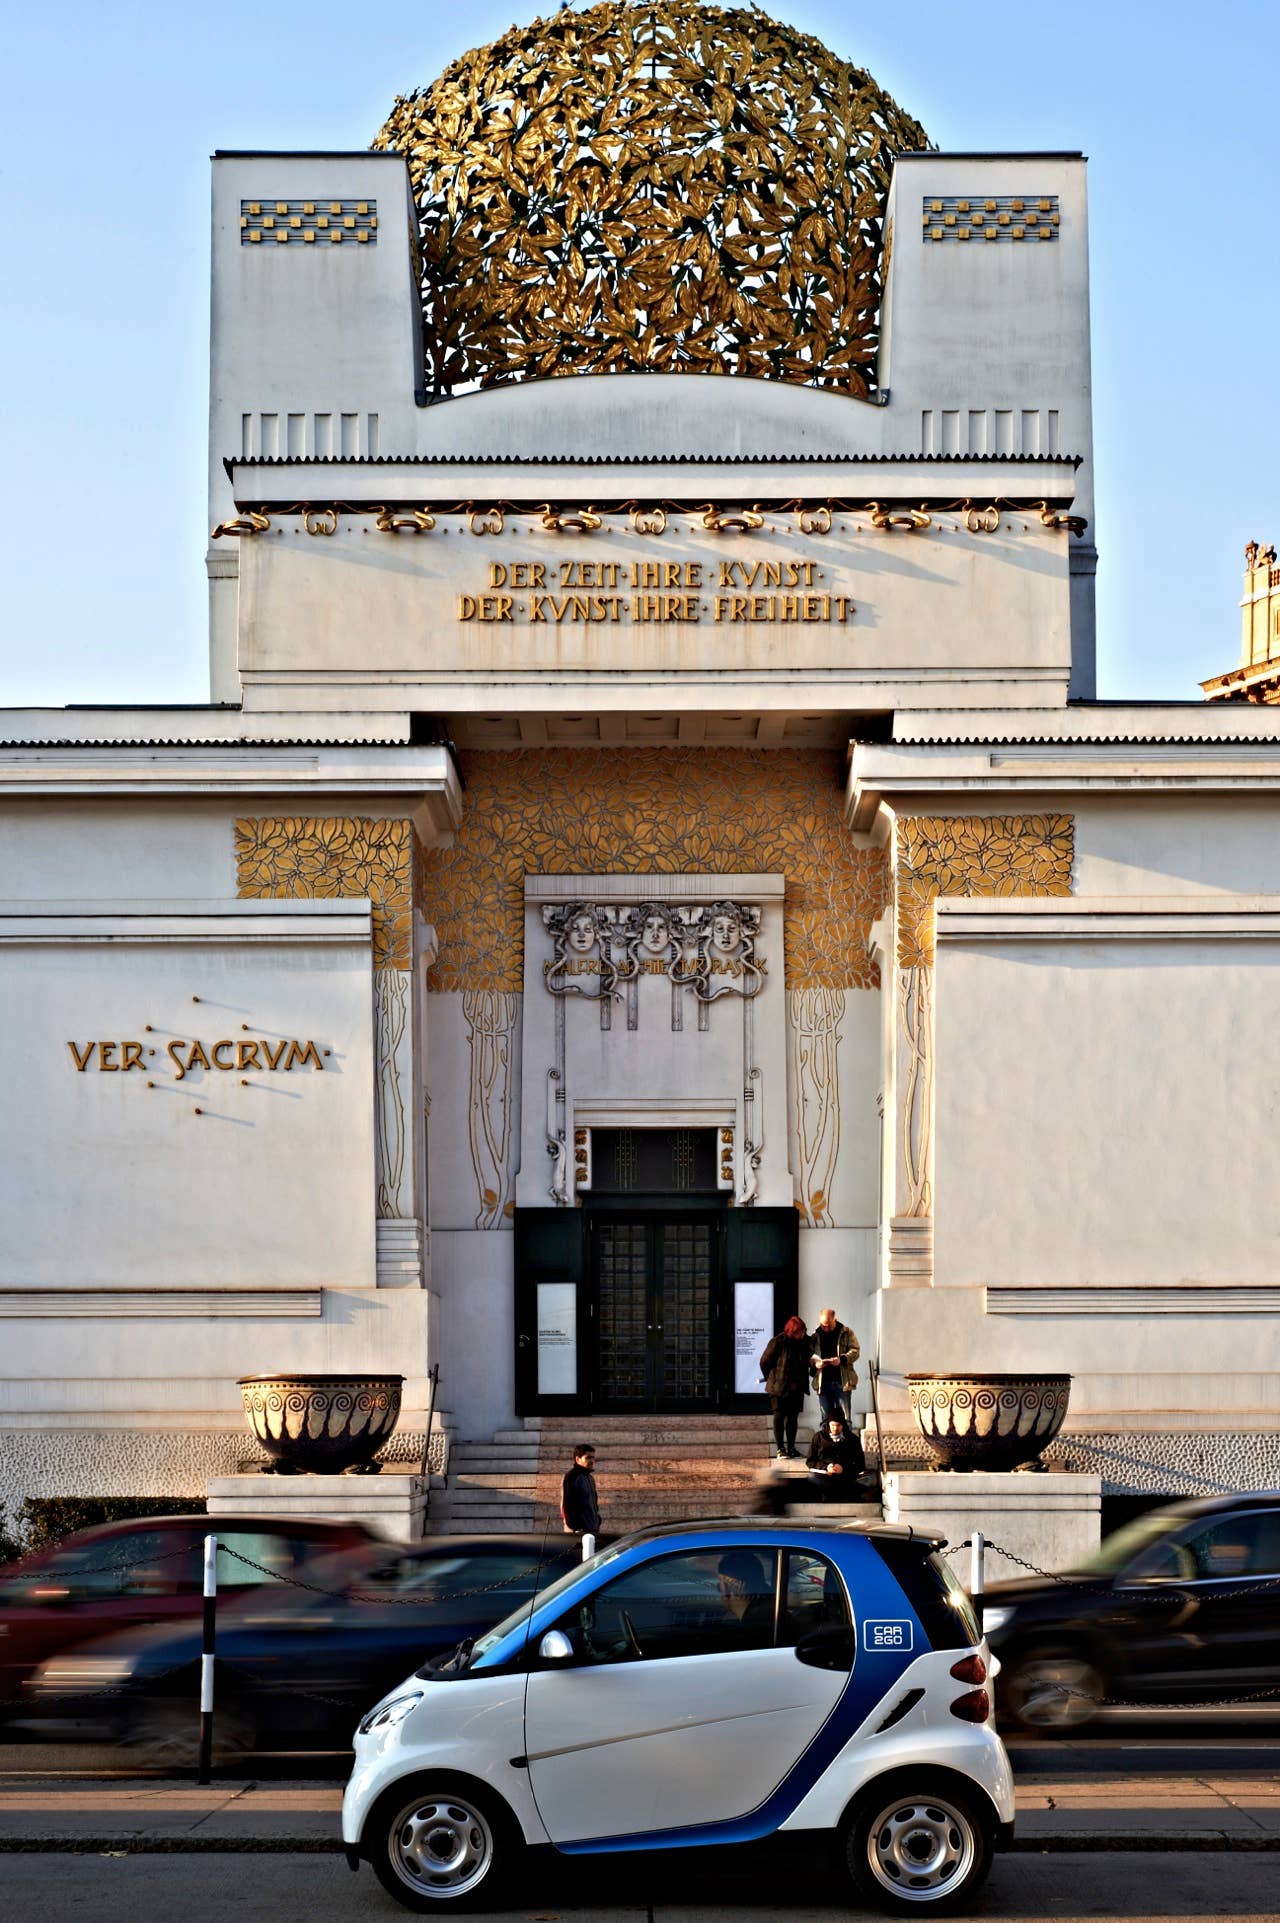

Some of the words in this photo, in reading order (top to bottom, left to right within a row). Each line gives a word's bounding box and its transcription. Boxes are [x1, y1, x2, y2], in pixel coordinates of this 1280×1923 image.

[489, 561, 546, 588] DER
[559, 561, 621, 588] ZEIT
[630, 561, 703, 588] IHRE
[458, 594, 513, 621] DER
[631, 594, 699, 622] IHRE
[714, 594, 852, 622] FREIHEIT
[67, 1041, 147, 1072] VER
[167, 1040, 324, 1080] SACRVM
[874, 1626, 903, 1636] CAR
[874, 1635, 903, 1645] 2GO
